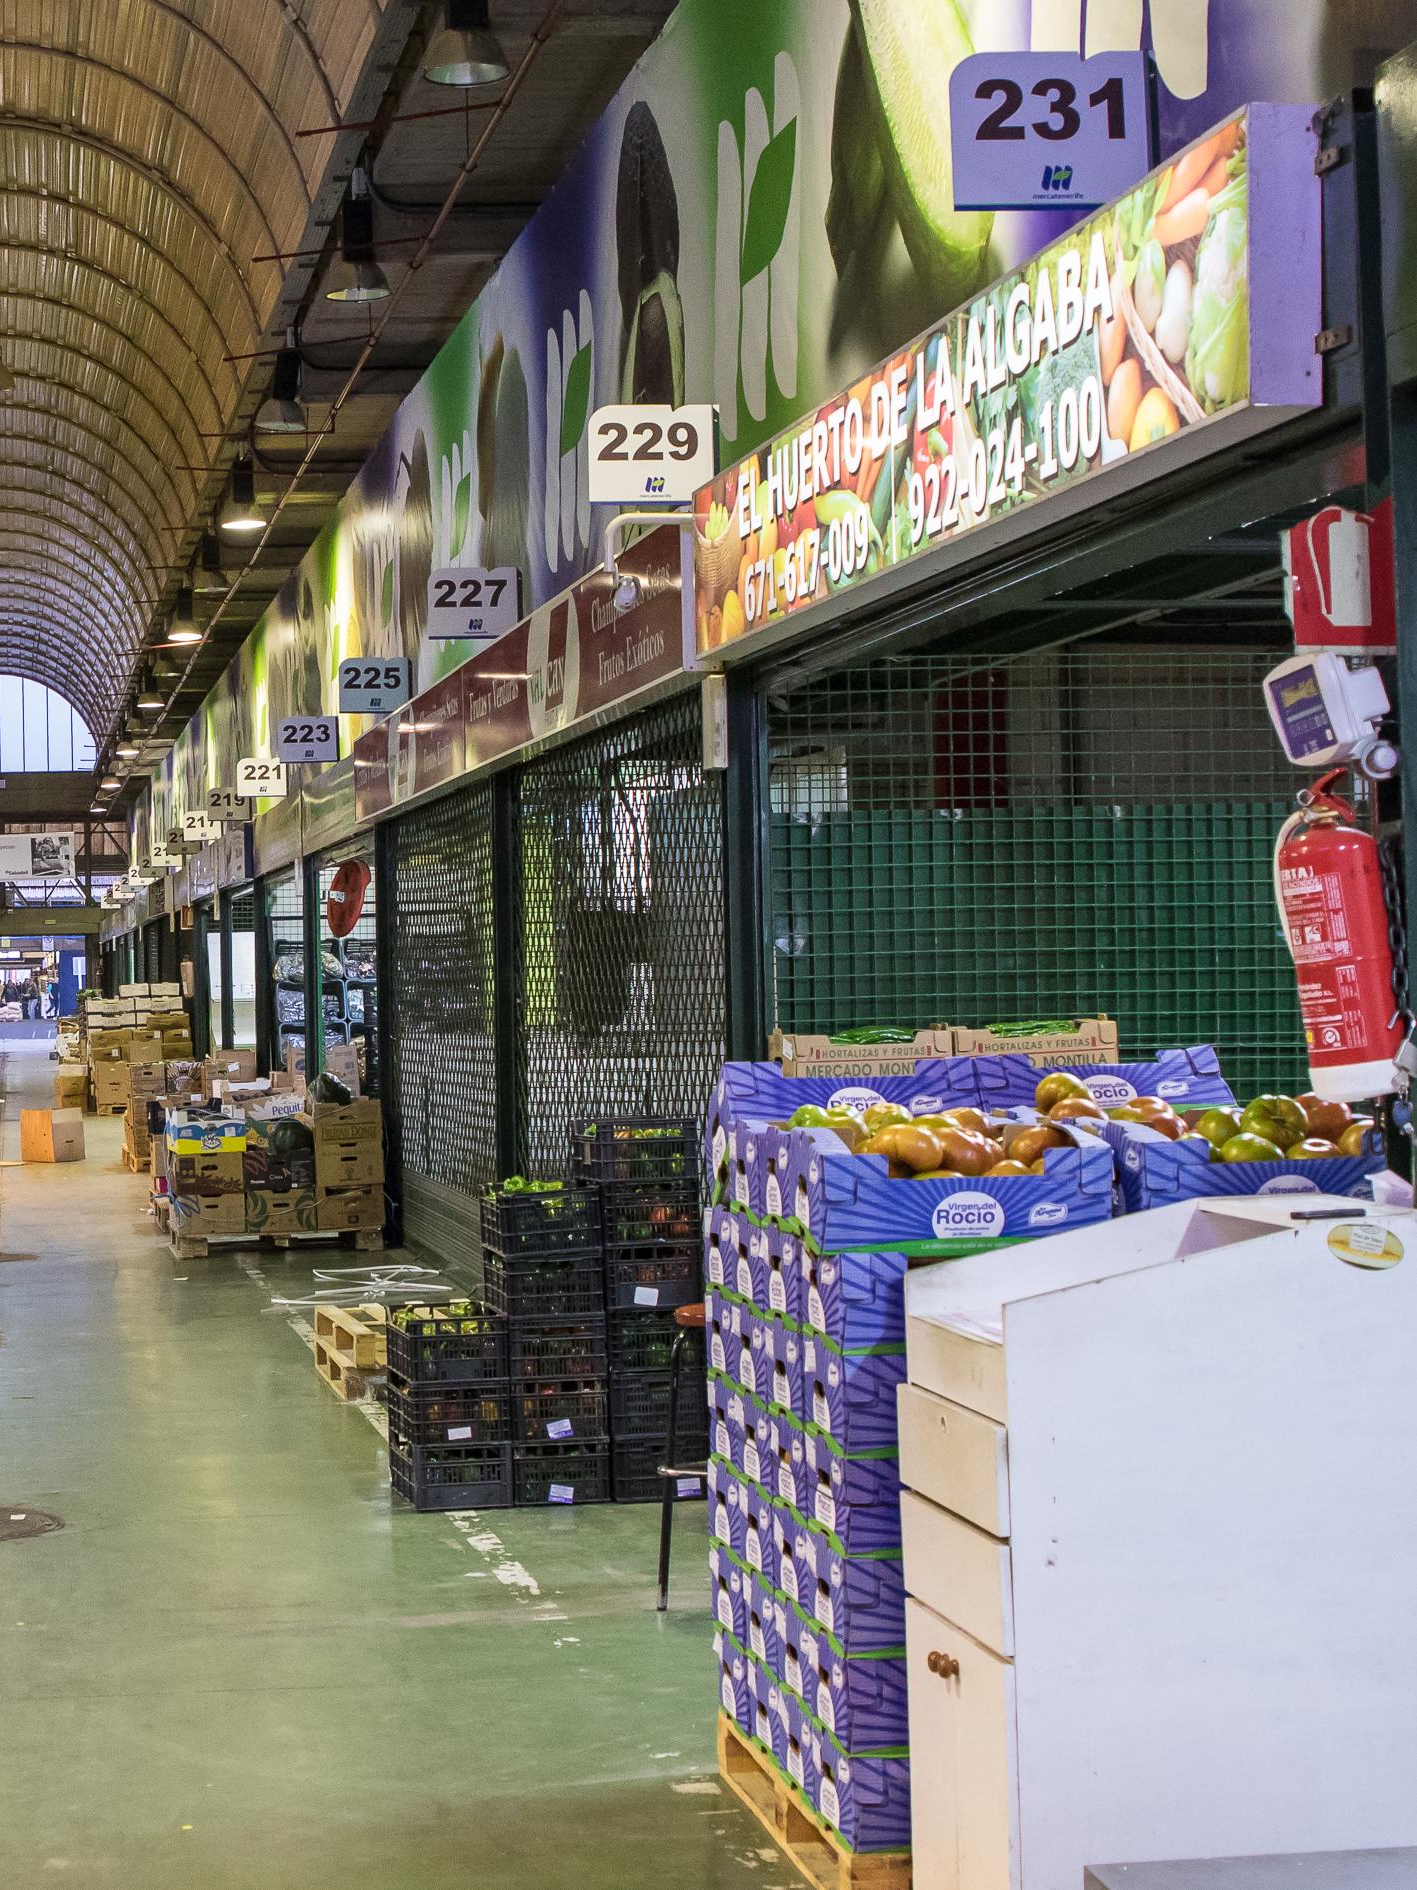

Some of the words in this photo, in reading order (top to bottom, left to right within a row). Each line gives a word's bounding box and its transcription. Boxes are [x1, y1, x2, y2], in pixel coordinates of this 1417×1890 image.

[974, 78, 1126, 140] 231
[737, 473, 764, 540] EL
[766, 400, 864, 525] HUERTO
[869, 363, 910, 462] DE
[915, 334, 957, 434] LA
[963, 230, 1115, 399] ALGABA
[597, 422, 699, 461] 229
[744, 500, 870, 622] 671-617-009
[909, 376, 1103, 546] 922-024-100
[433, 579, 508, 608] 227
[598, 651, 625, 686] Frutos
[626, 625, 665, 673] Exóticos
[343, 667, 402, 690] 225
[282, 724, 331, 744] 223
[243, 764, 283, 781] 221
[210, 792, 245, 807] 219
[821, 1048, 880, 1060] HORTALIZAS
[881, 1048, 891, 1058] Y
[892, 1045, 926, 1057] FRUTAS
[984, 1040, 1044, 1053] HORTALIZAS
[1045, 1040, 1055, 1050] Y
[1056, 1037, 1090, 1048] FRUTAS
[1042, 1053, 1108, 1069] MONTILLA
[805, 1063, 872, 1079] MERCADO
[839, 1095, 866, 1103] Virgen
[1092, 1086, 1129, 1099] ocío
[948, 1202, 979, 1212] Virgen
[981, 1202, 997, 1210] del
